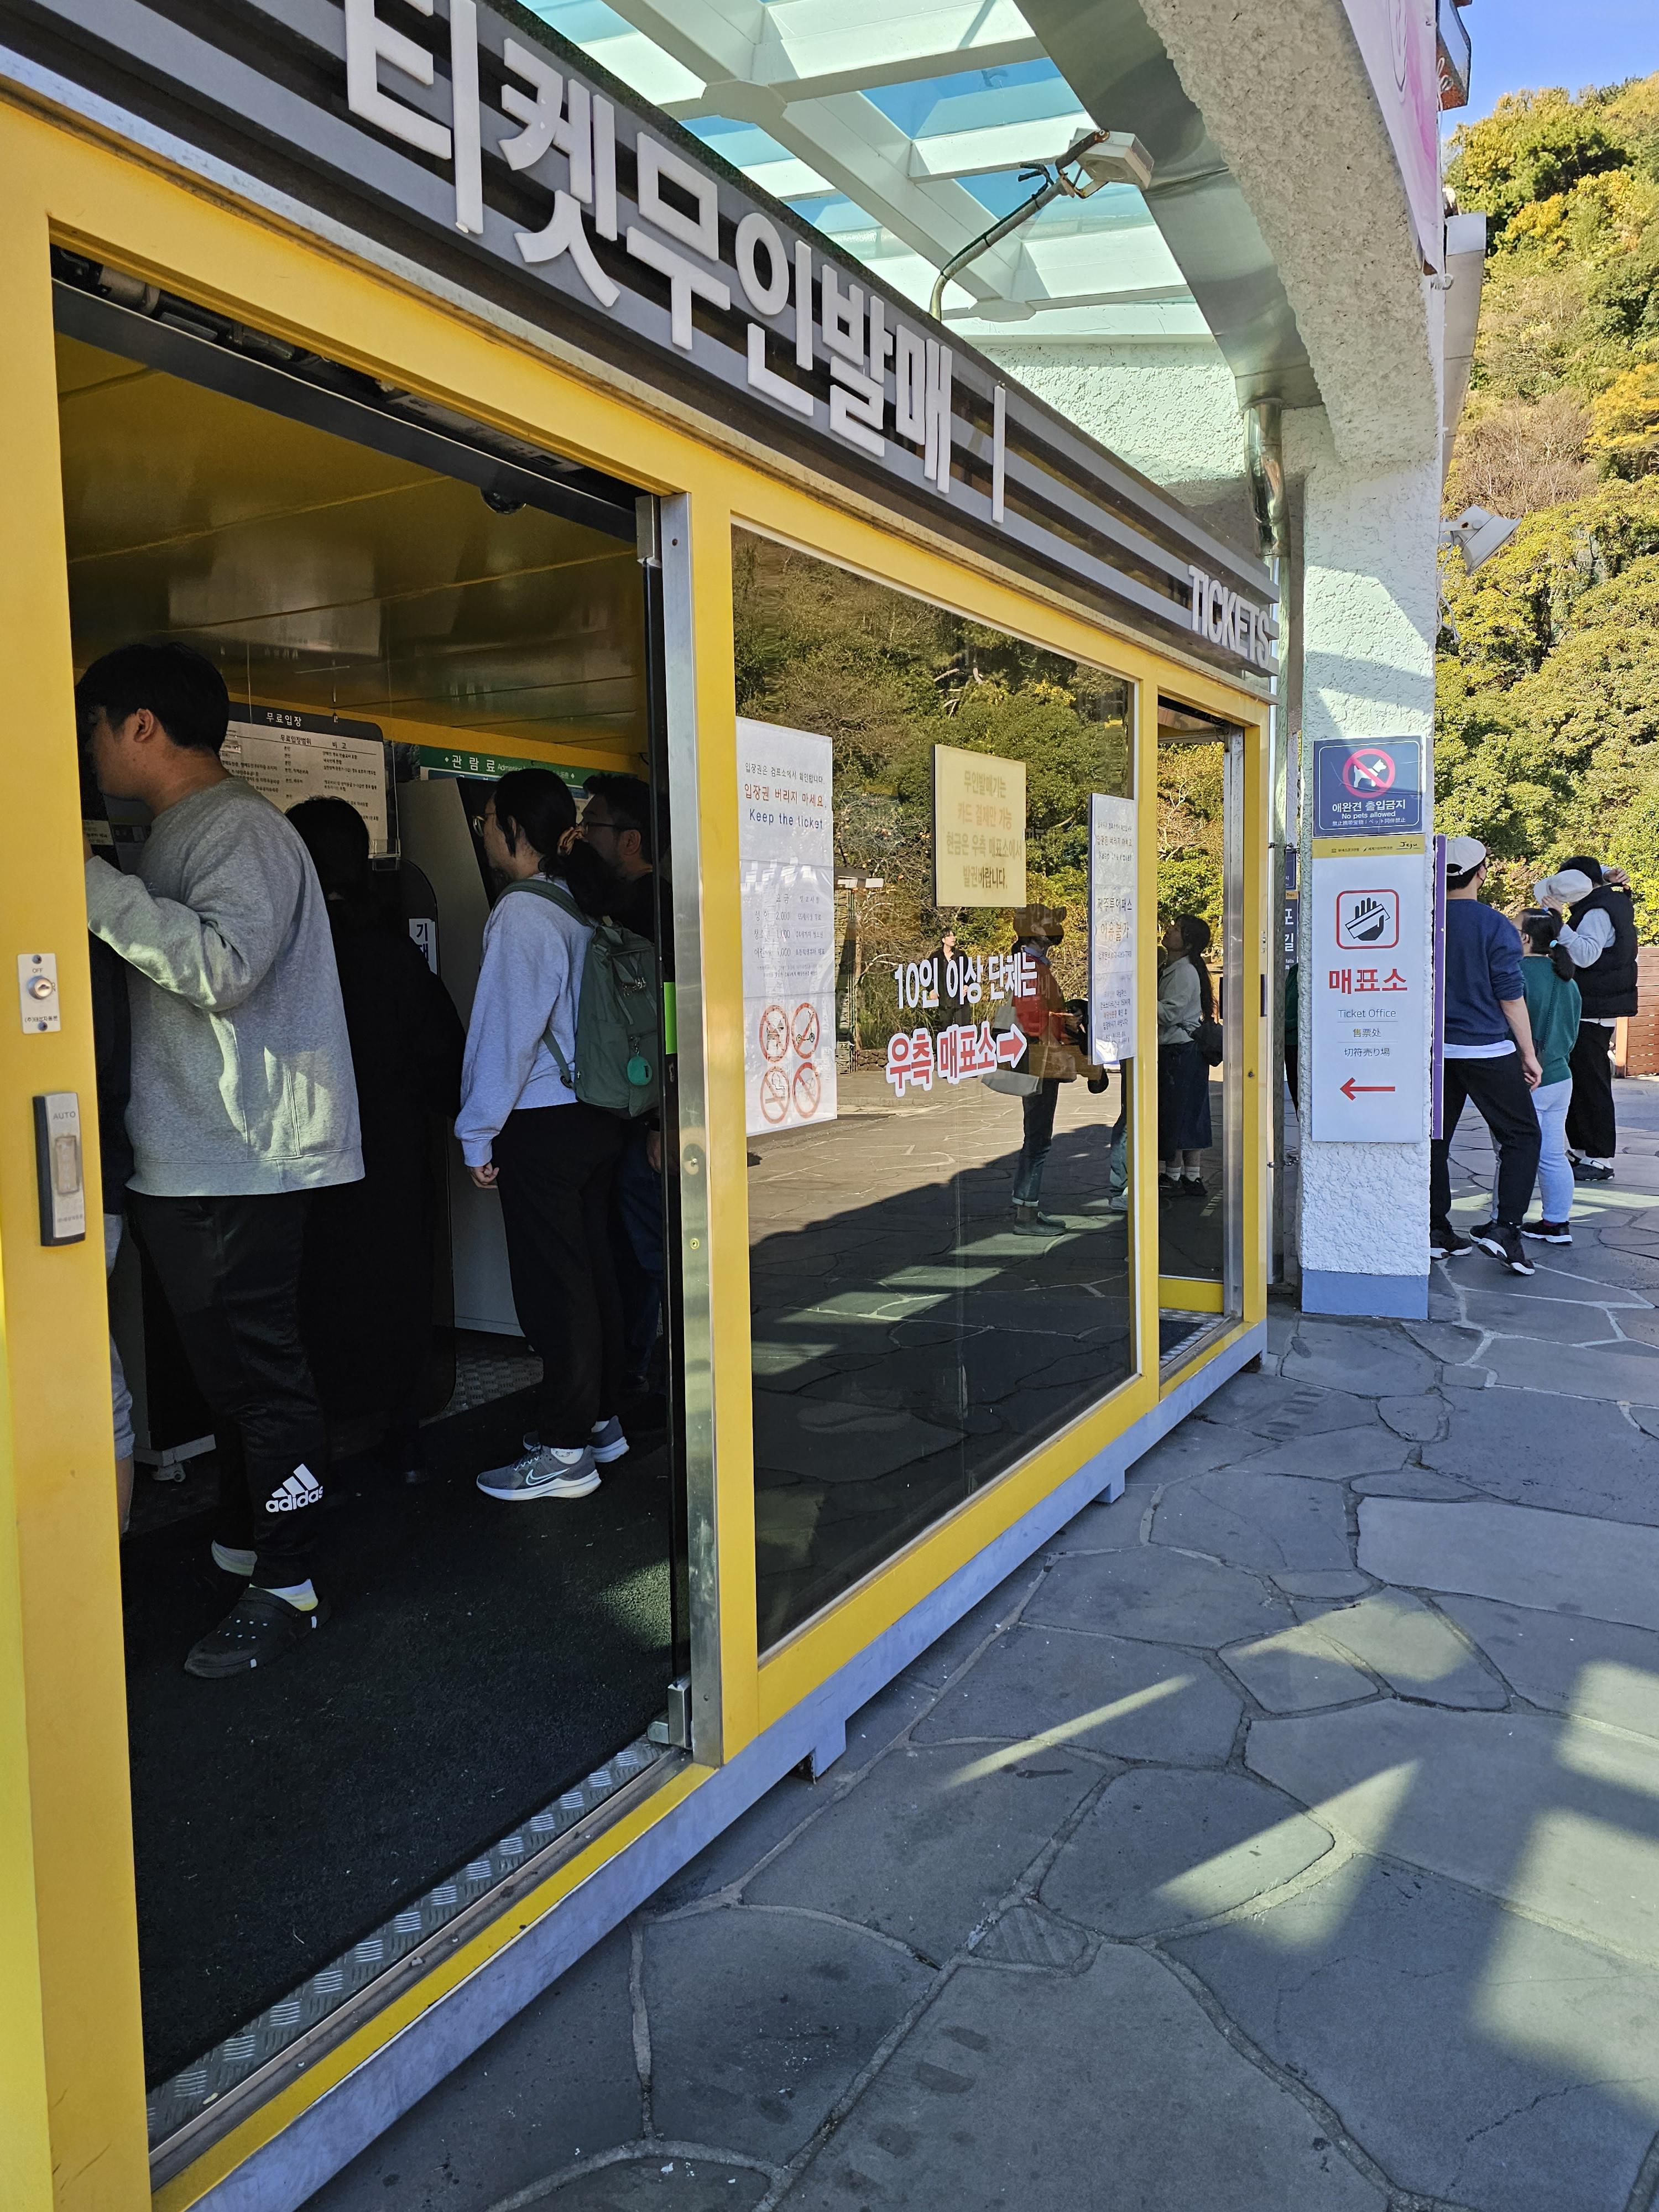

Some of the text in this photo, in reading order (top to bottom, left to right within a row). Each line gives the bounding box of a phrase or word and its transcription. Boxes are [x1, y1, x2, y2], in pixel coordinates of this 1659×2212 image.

[1188, 565, 1270, 669] TICKETS
[266, 712, 302, 727] 무료입장
[745, 763, 768, 775] 입장권은
[964, 770, 1006, 798] 무인발매기는
[744, 783, 827, 808] 입장권 버리지 마세요.
[1332, 799, 1406, 813] 애완견 출입금지
[749, 808, 823, 829] Keep the ticket
[957, 801, 1013, 831] 카드 결제만 가능
[947, 831, 1022, 860] 현금은 우측 매표소에서
[1097, 898, 1133, 912] 제주투어패스
[776, 911, 790, 921] 2,000
[1100, 921, 1129, 942] 이용불가
[895, 957, 939, 1009] 10인
[946, 956, 983, 1005] 이상
[989, 952, 1037, 1000] 단체는
[1329, 968, 1407, 994] 매표소
[1338, 1008, 1396, 1018] Ticket Office
[1353, 1028, 1381, 1038] 售票处
[888, 1024, 997, 1093] 우측 매표소
[1344, 1047, 1391, 1058] 切符売り場
[53, 1111, 76, 1120] AUTO
[265, 1486, 323, 1512] adidas
